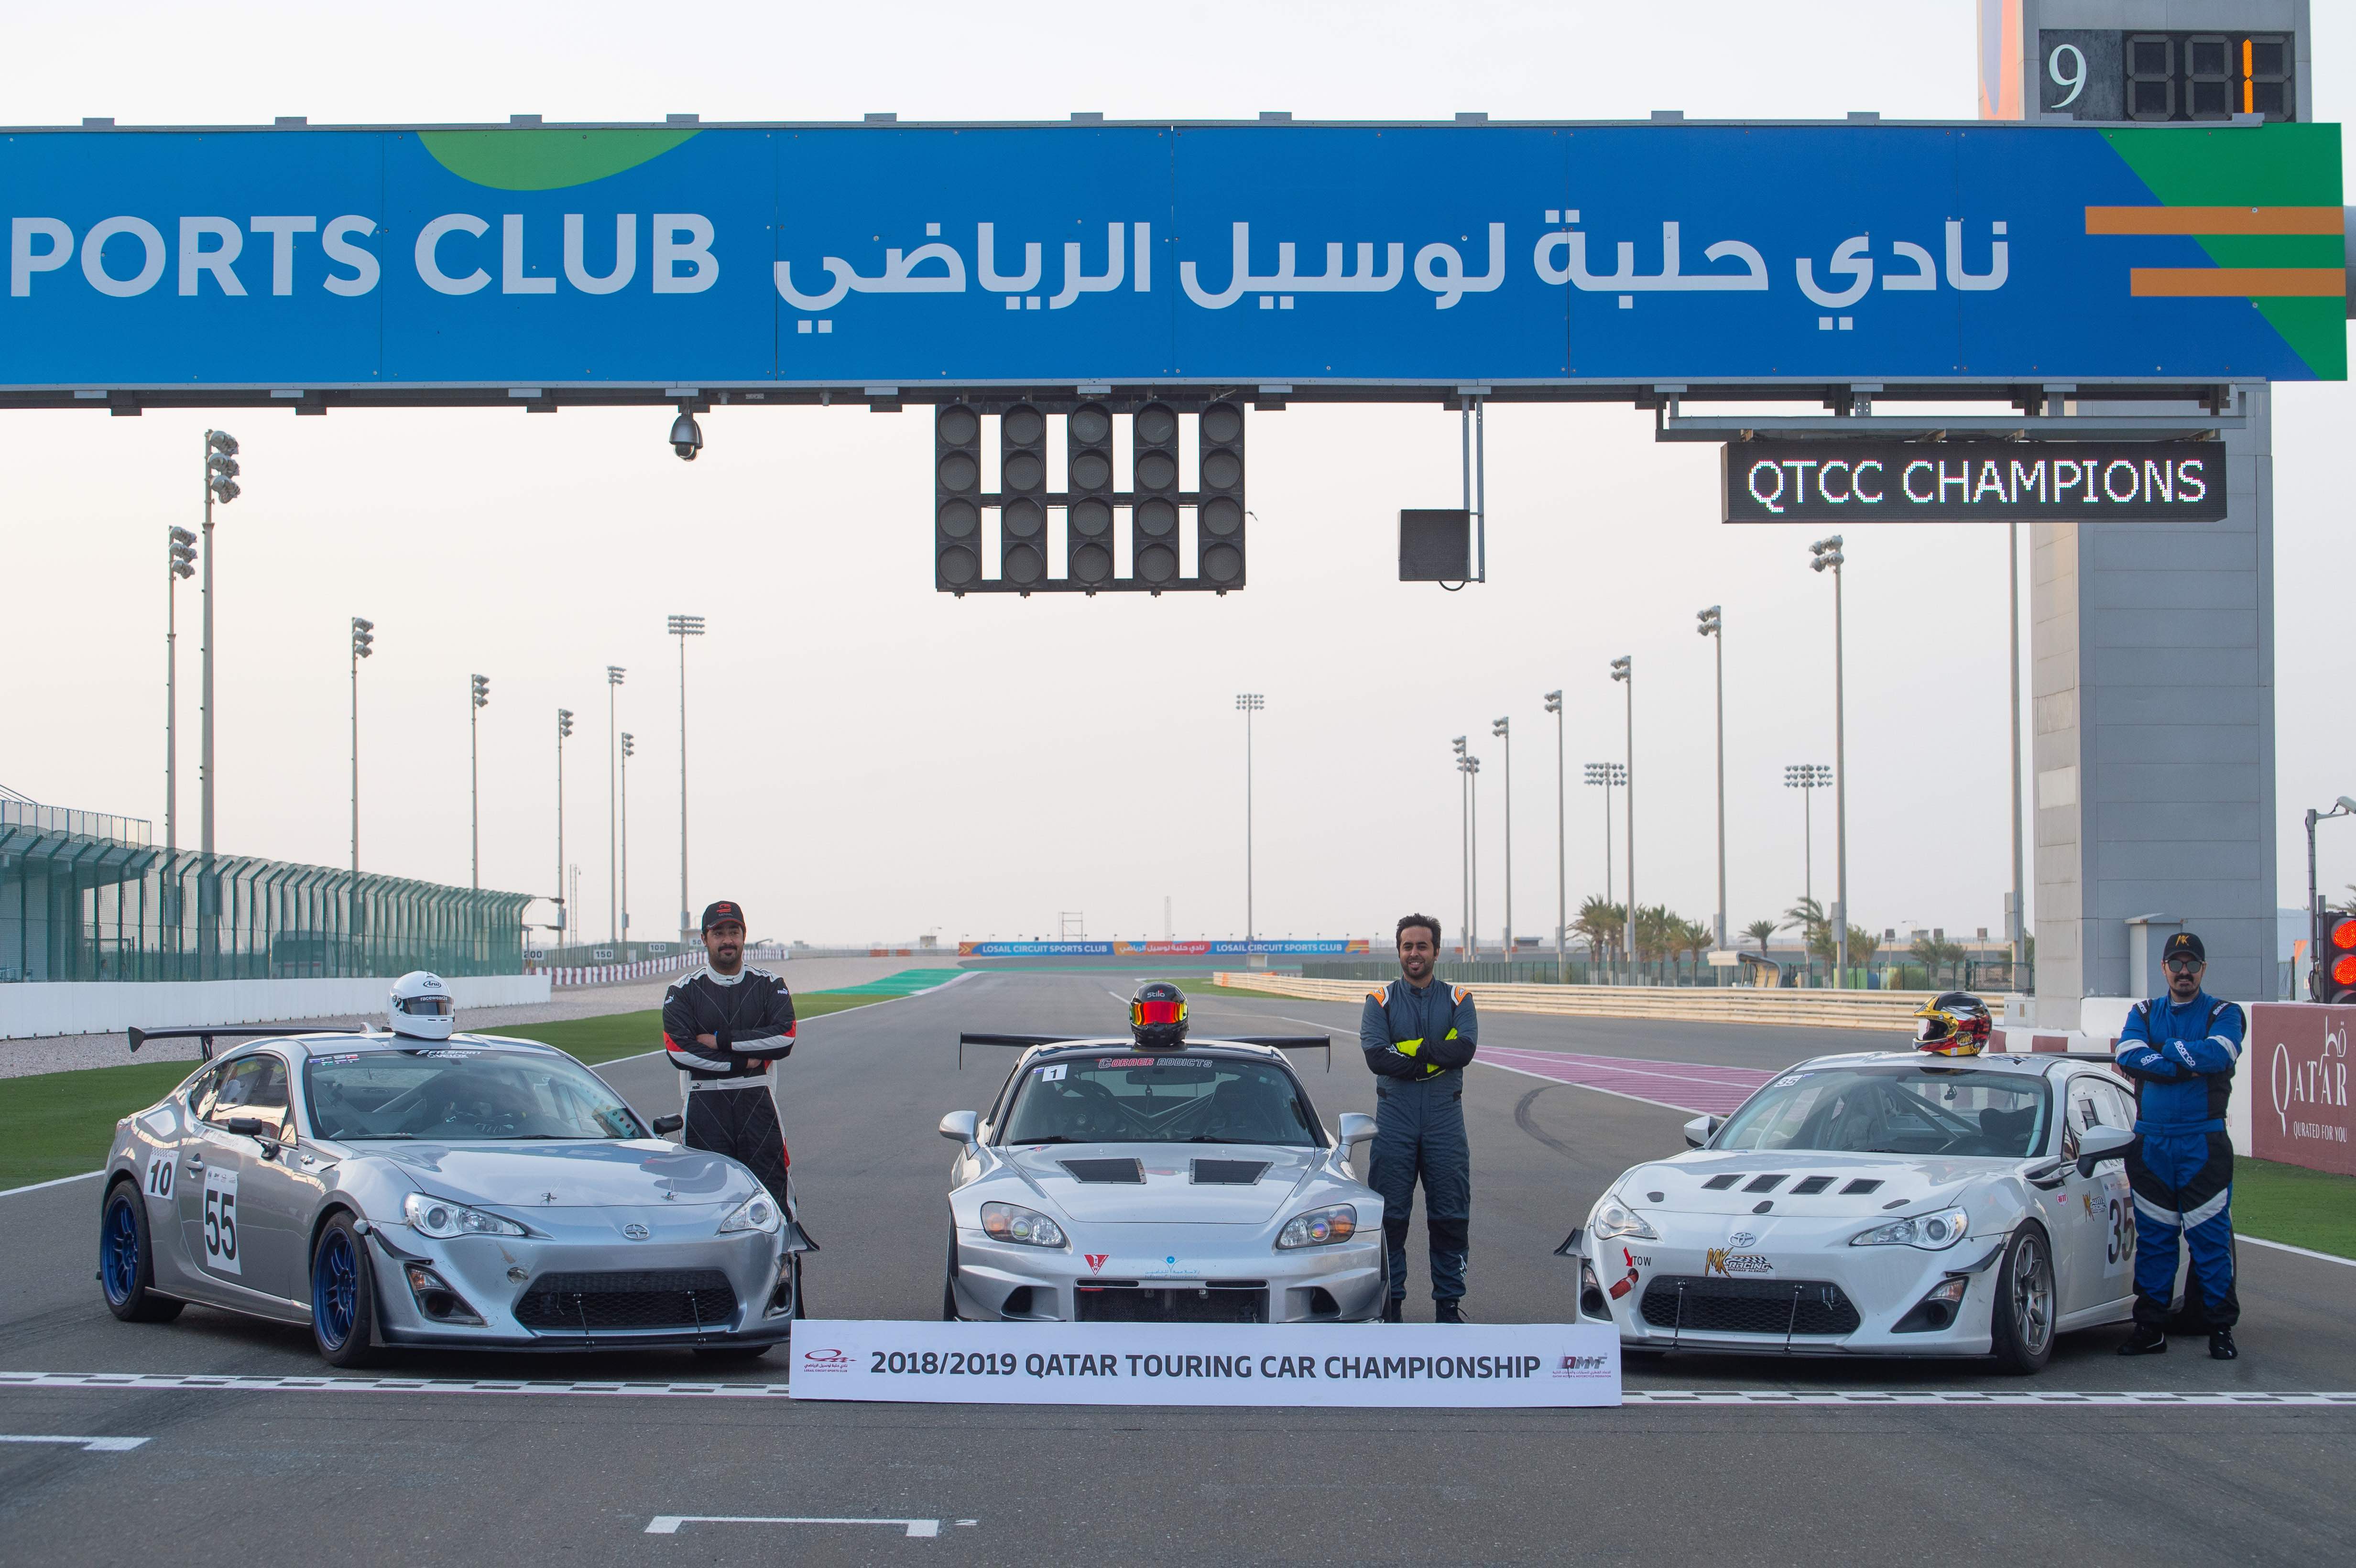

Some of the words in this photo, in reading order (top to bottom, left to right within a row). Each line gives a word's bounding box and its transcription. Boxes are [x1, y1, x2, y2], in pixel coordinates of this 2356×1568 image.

[11, 215, 381, 297] PORTS
[414, 213, 719, 295] CLUB
[1180, 222, 1505, 310] لوسيل
[1534, 209, 1769, 309] حلبة
[774, 222, 1151, 334] الرياضي
[1796, 221, 2008, 330] نادي
[1748, 460, 1883, 513] QTCC
[1903, 460, 2206, 503] CHAMPIONS
[524, 950, 542, 958] 200
[982, 945, 1011, 953] LOSAIL
[1013, 945, 1047, 953] CIRCUIT
[1084, 944, 1108, 952] CLUB
[1216, 944, 1247, 952] LOSAIL
[1248, 944, 1282, 952] CIRCUIT
[1284, 944, 1317, 952] SPORTS
[1319, 943, 1342, 952] CLUB
[1147, 990, 1165, 998] stilo
[1098, 1057, 1155, 1069] CORNER
[1156, 1058, 1213, 1068] ADDICTS
[2140, 1053, 2163, 1066] spar
[2174, 1040, 2196, 1067] sparco
[1050, 1069, 1058, 1079] 1
[1777, 1078, 1799, 1086] 35
[2272, 1043, 2347, 1138] QATAR
[2293, 1121, 2320, 1140] QURATED
[2322, 1124, 2333, 1141] FOR
[2334, 1126, 2347, 1143] YOU
[151, 1159, 172, 1196] 10
[205, 1188, 237, 1261] 55
[2108, 1197, 2135, 1264] 35
[1633, 1255, 1651, 1266] TOW
[1705, 1247, 1734, 1278] MK
[1728, 1262, 1770, 1270] RACING
[871, 1351, 1017, 1375] 2018/2019
[1025, 1353, 1118, 1379] QATAR
[1125, 1354, 1252, 1378] TOURING
[1260, 1355, 1317, 1379] CAR
[1324, 1356, 1541, 1379] CHAMPIONSHIP
